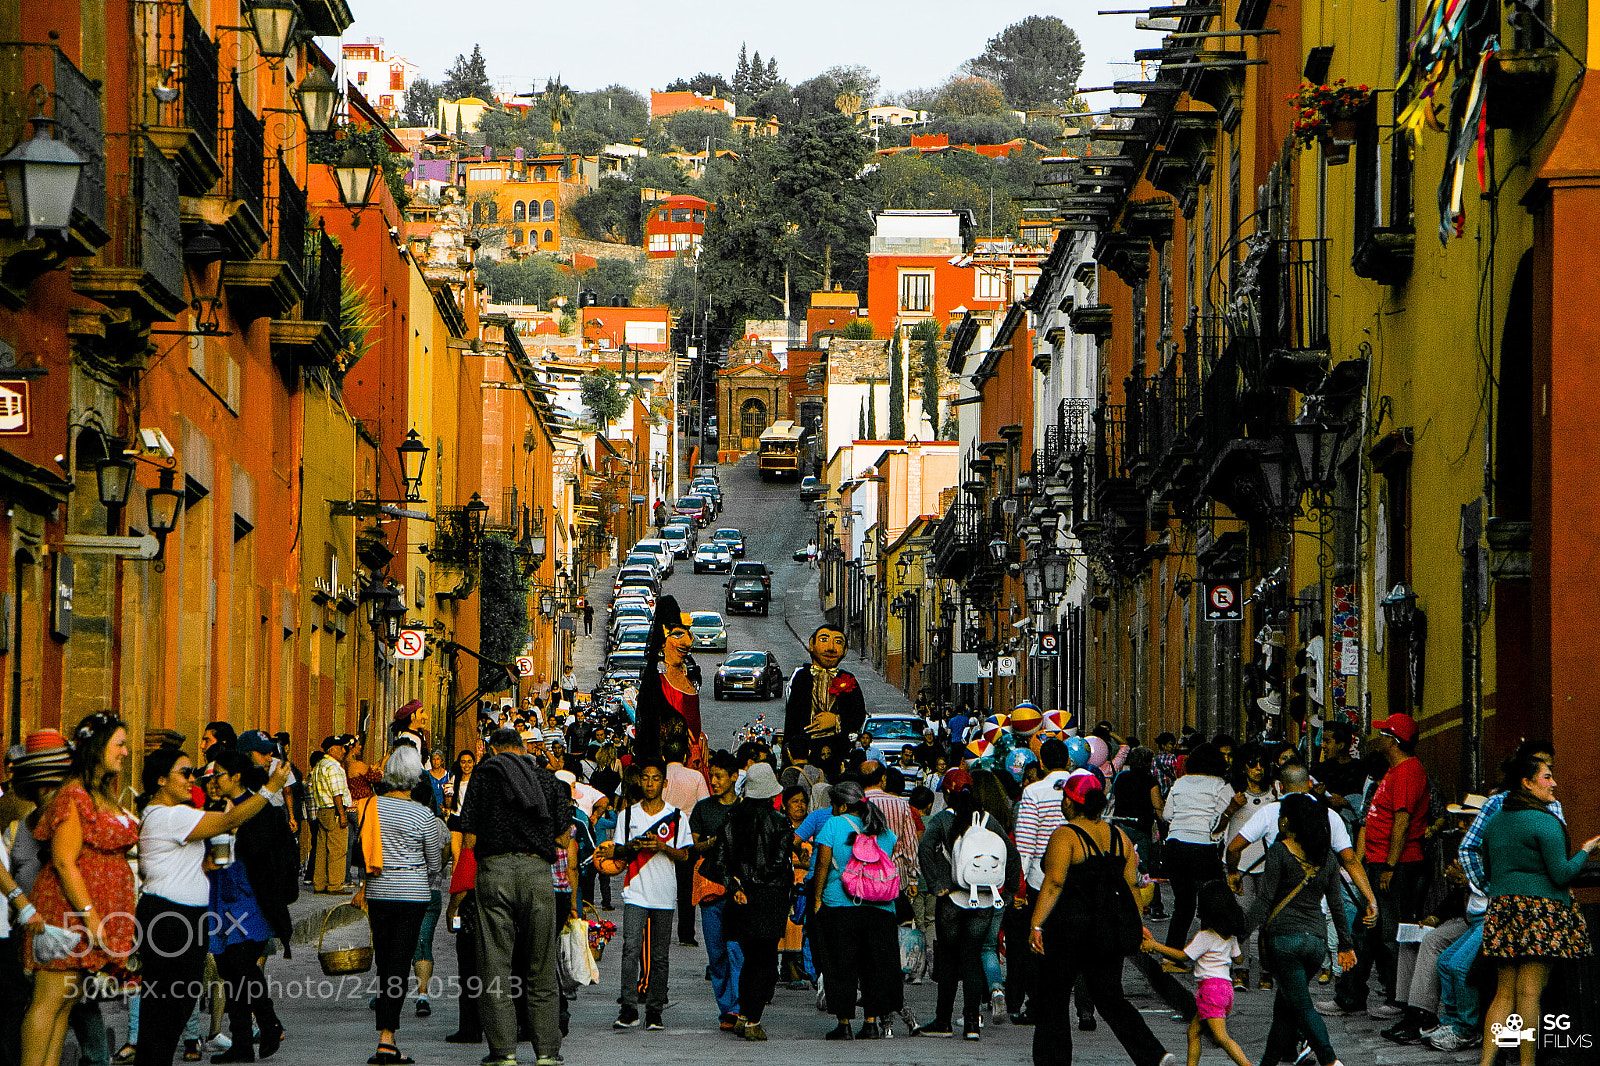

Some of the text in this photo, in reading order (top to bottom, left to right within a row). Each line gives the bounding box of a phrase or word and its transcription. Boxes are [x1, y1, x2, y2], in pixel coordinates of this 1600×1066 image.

[1218, 591, 1227, 603] E
[404, 637, 414, 650] E
[1349, 654, 1357, 666] 2
[520, 661, 527, 672] E
